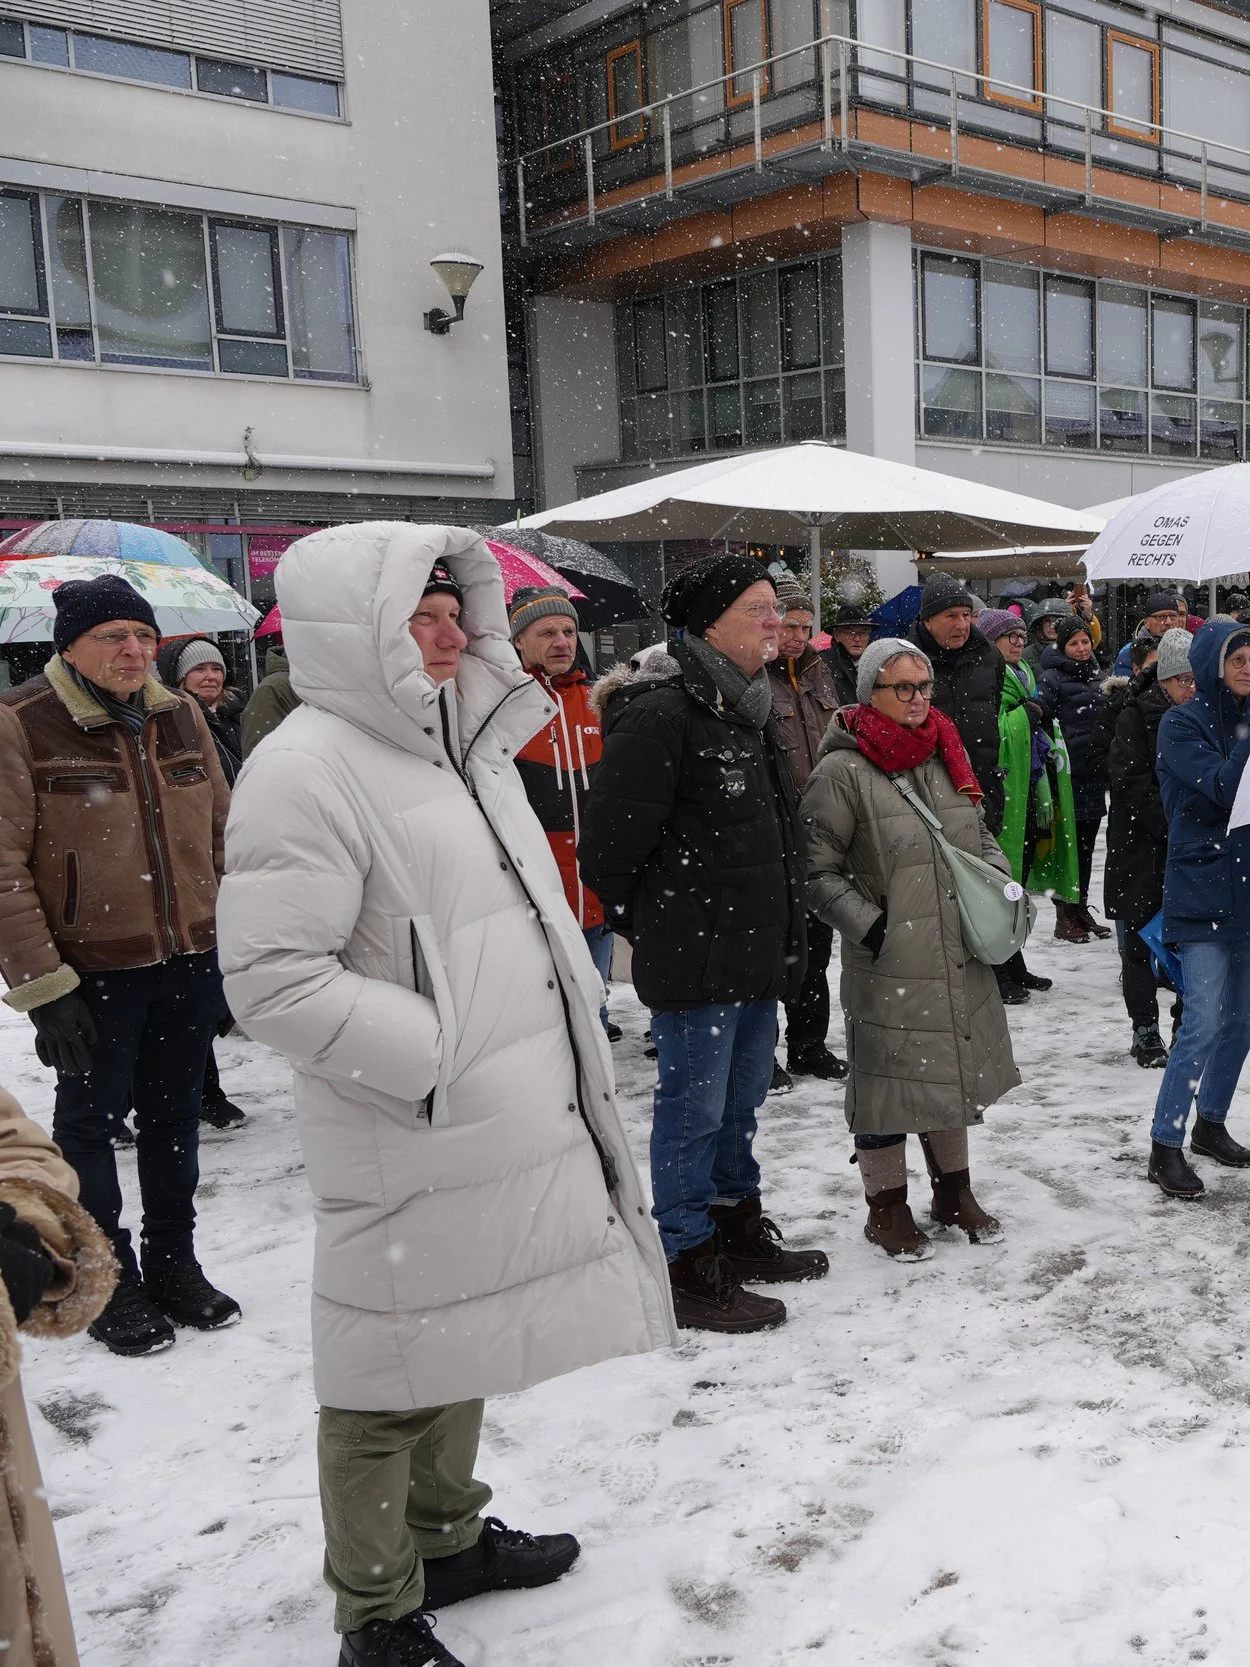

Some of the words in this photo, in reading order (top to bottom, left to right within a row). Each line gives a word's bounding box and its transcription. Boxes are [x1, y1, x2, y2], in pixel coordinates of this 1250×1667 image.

[1153, 515, 1191, 528] OMAS
[1140, 533, 1185, 547] GEGEN
[1127, 552, 1177, 566] RECHTS
